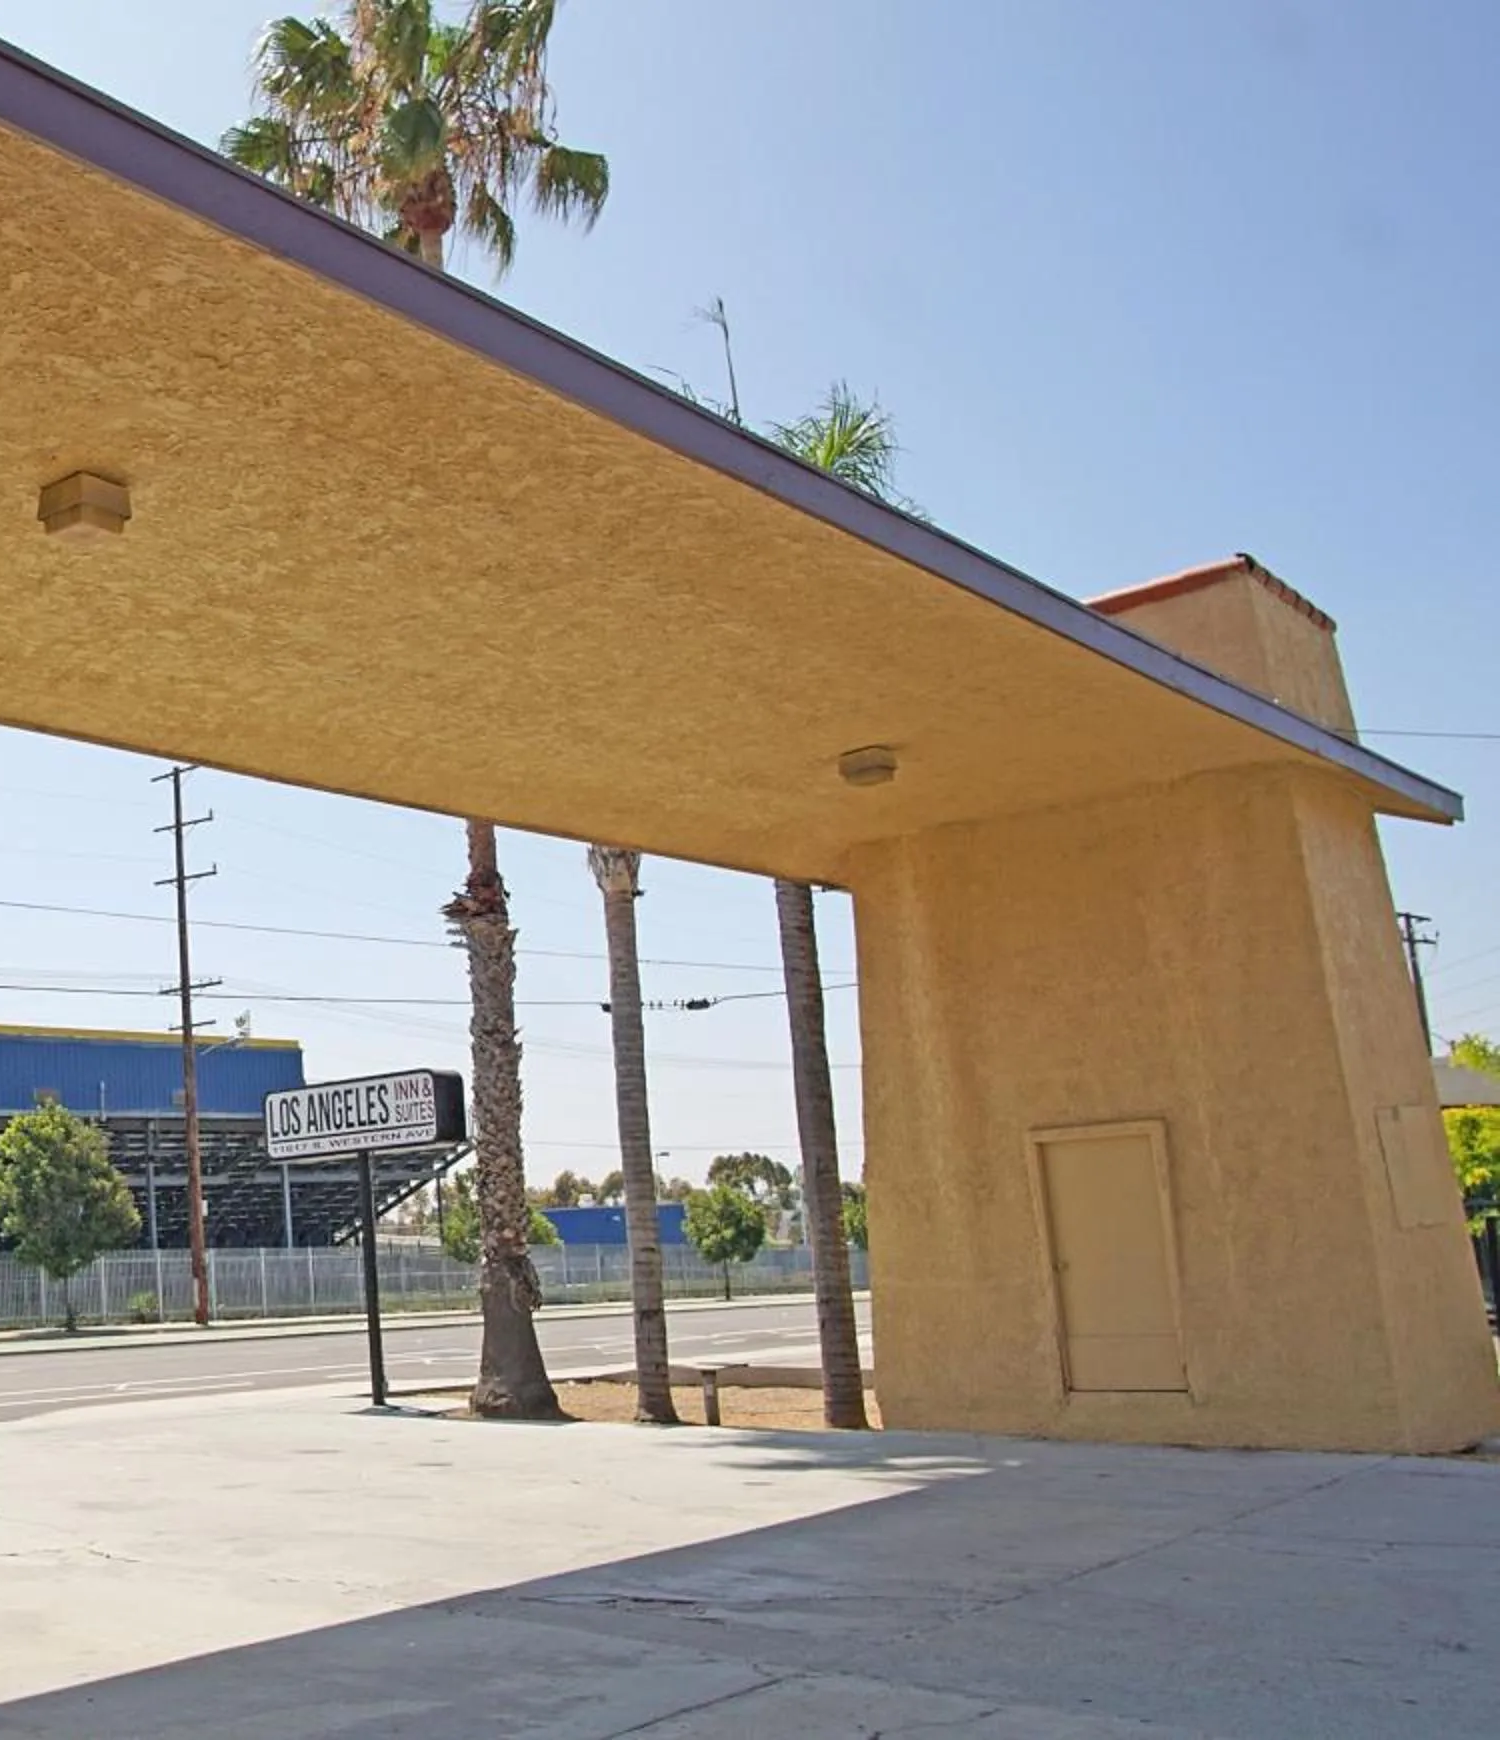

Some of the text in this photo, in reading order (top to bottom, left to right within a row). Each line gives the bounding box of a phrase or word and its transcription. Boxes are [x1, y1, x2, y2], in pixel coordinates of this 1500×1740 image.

[393, 1077, 432, 1100] INN &
[269, 1084, 390, 1138] LOS ANGELES
[395, 1101, 434, 1123] SUITES
[329, 1131, 401, 1148] WESTERN
